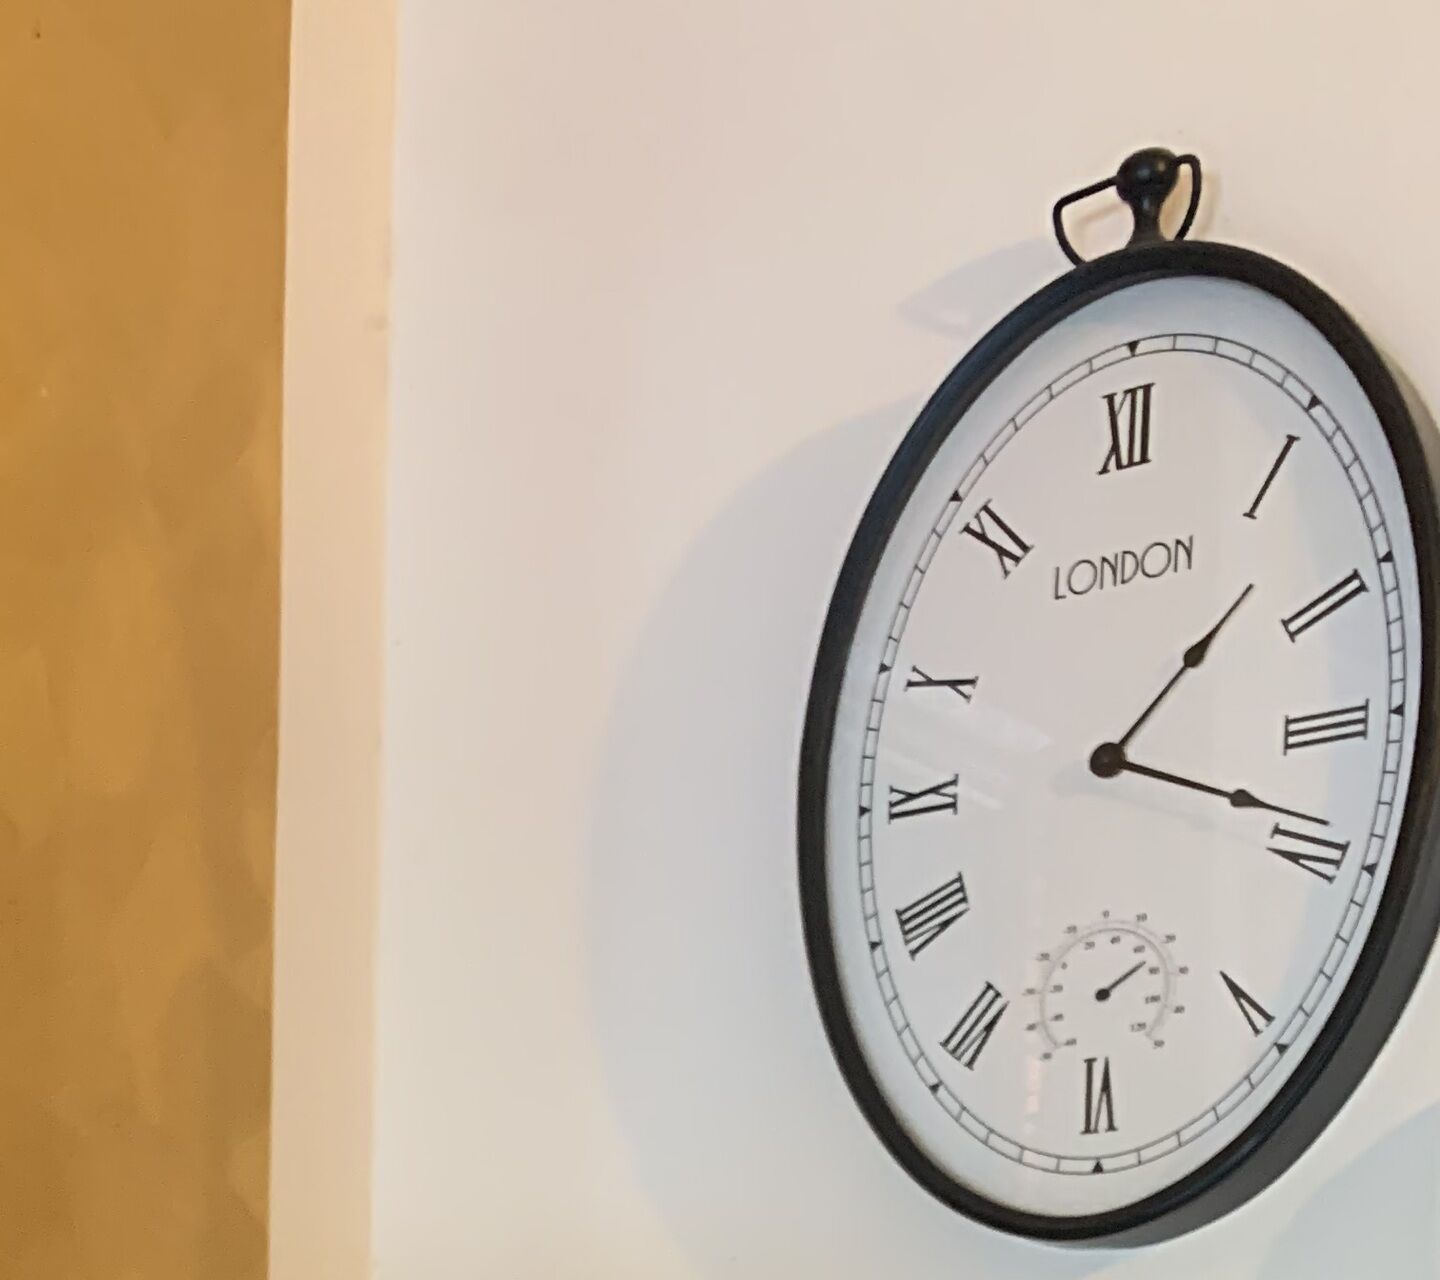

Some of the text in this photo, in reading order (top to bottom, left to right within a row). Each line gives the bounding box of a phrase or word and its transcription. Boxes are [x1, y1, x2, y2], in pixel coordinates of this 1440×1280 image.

[1097, 384, 1156, 475] XII
[961, 499, 1035, 579] XI
[1053, 535, 1196, 600] LONDON
